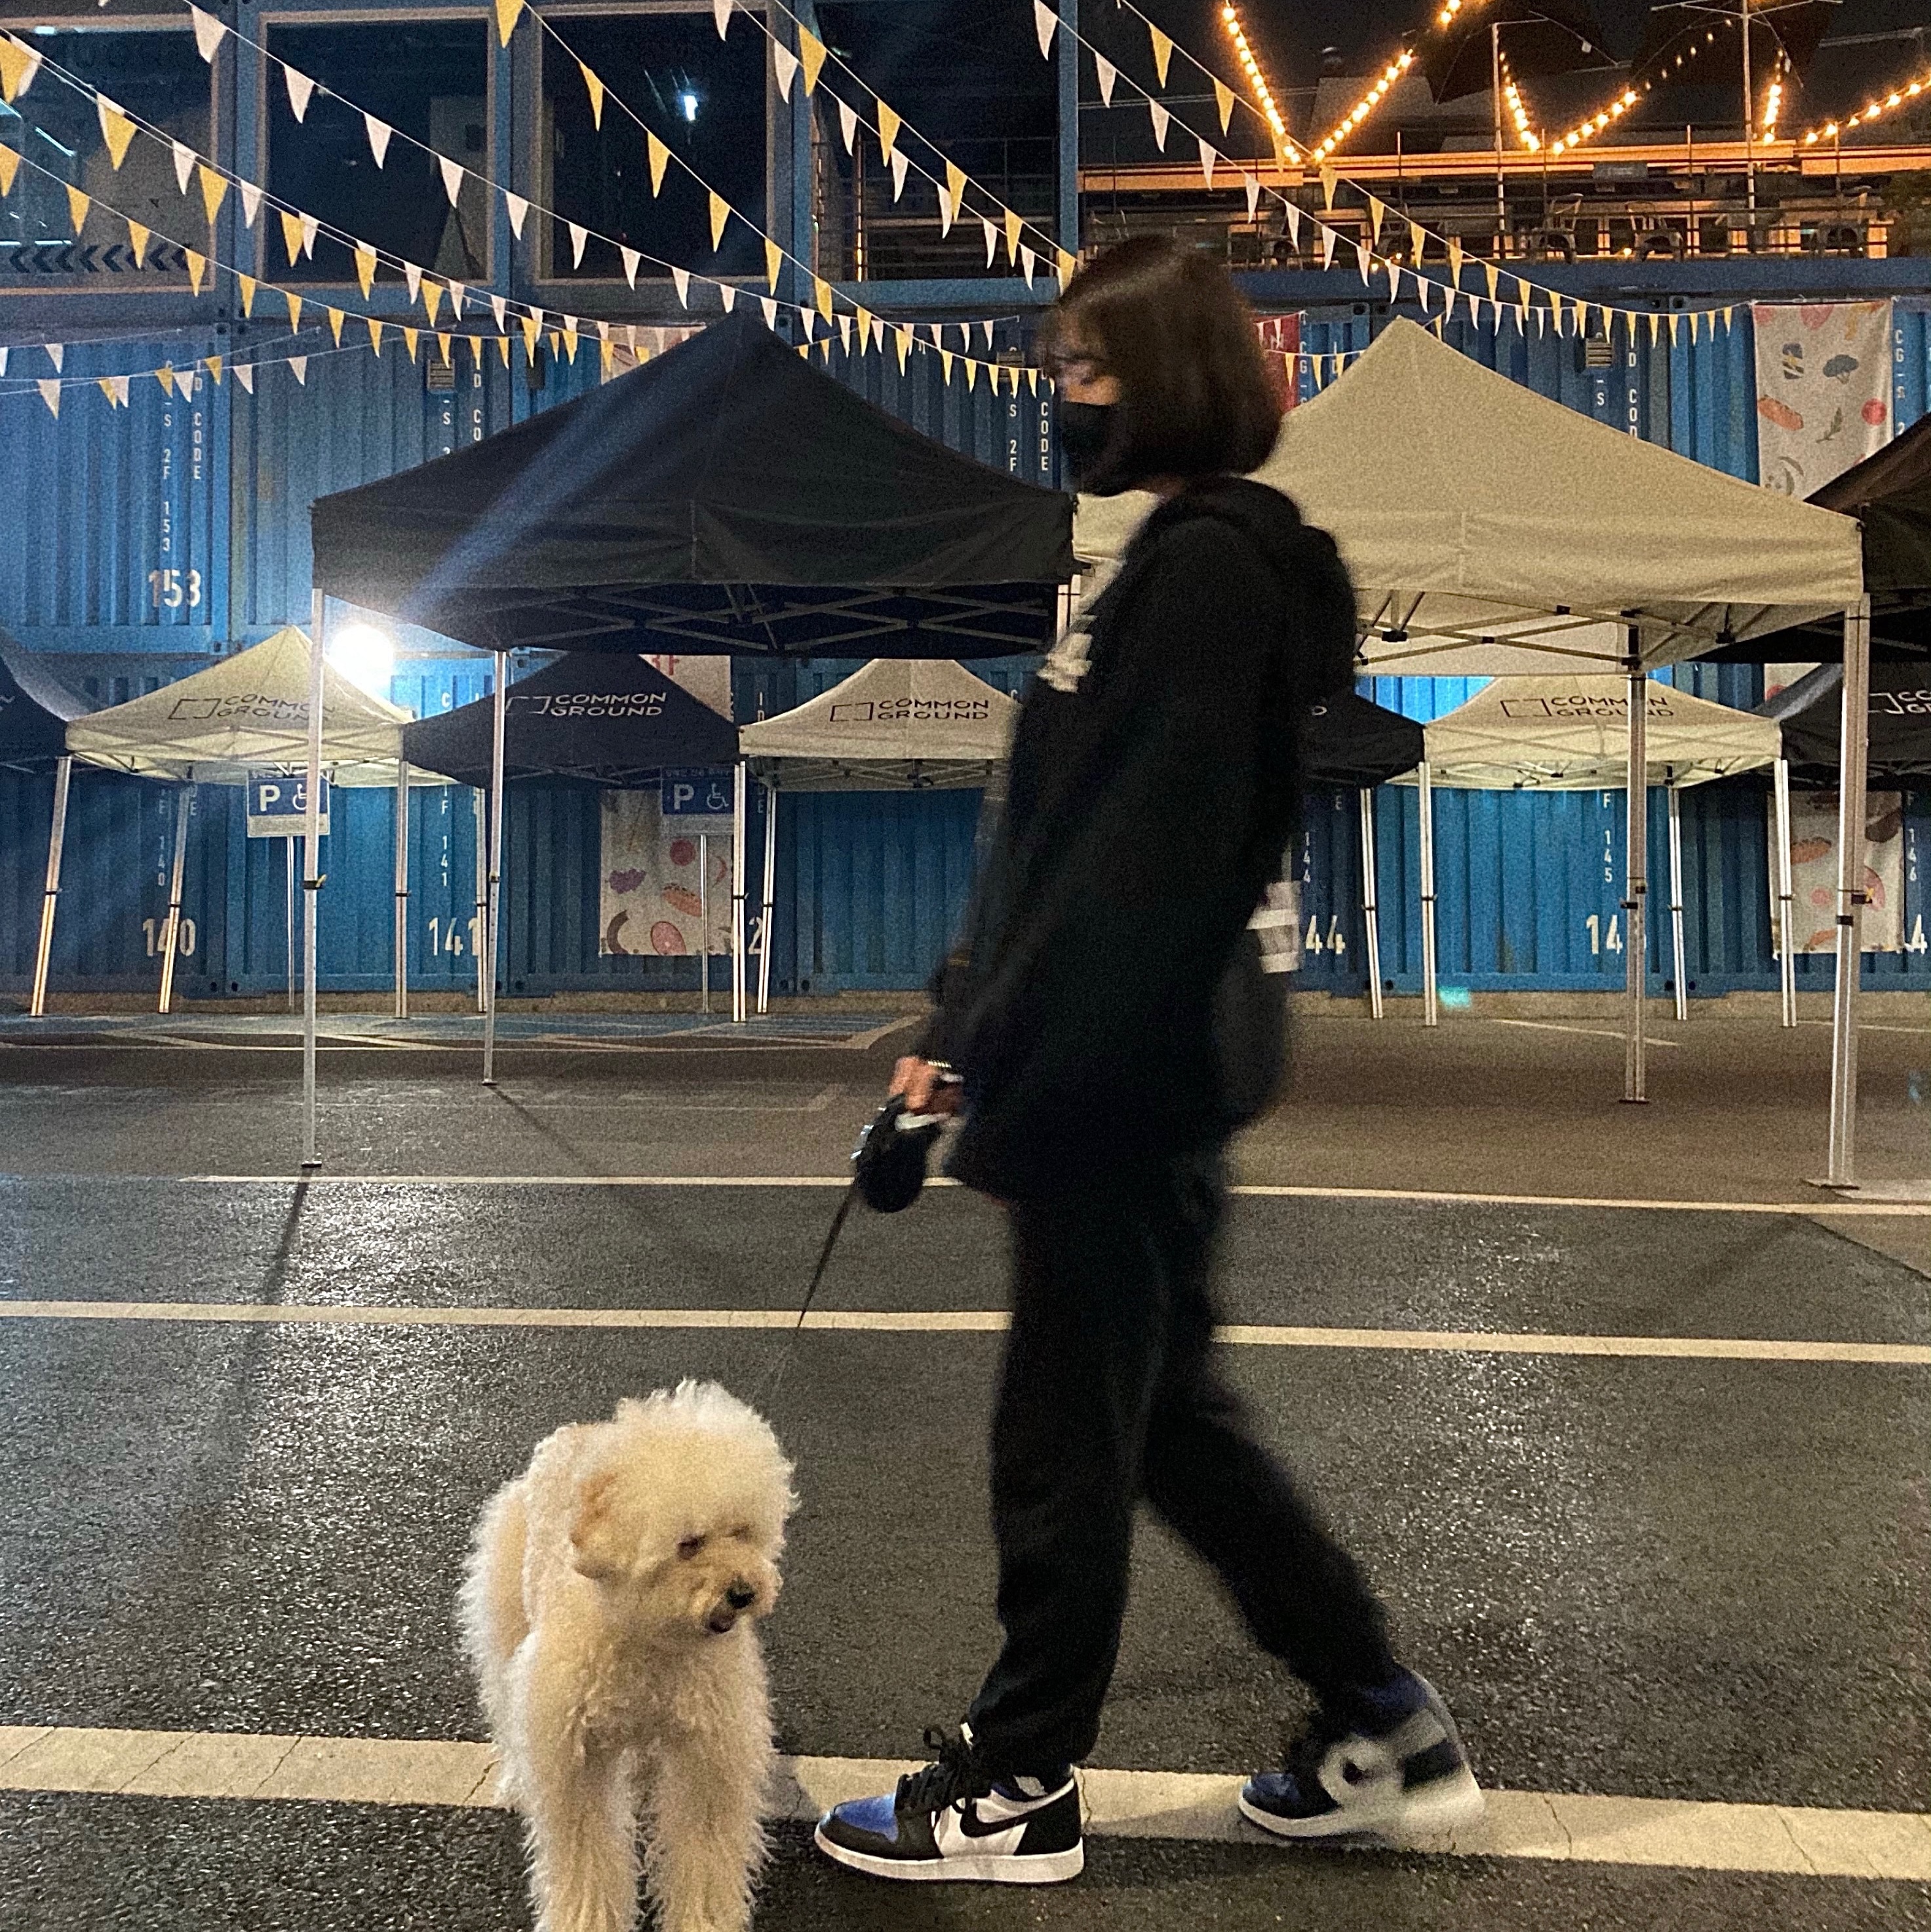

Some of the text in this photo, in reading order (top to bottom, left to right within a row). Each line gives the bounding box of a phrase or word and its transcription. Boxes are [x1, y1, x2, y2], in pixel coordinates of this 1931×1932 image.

[193, 412, 202, 480] CODE
[1040, 401, 1049, 471] CODE
[148, 568, 201, 608] 153
[551, 706, 662, 717] GROUND
[556, 692, 667, 705] COMMON
[878, 698, 989, 709] COMMON
[1551, 696, 1668, 706] COMMN
[878, 710, 988, 720] GROUND
[260, 785, 281, 812] P
[674, 783, 694, 810] P
[1306, 915, 1346, 954] 44
[1586, 915, 1624, 954] 14
